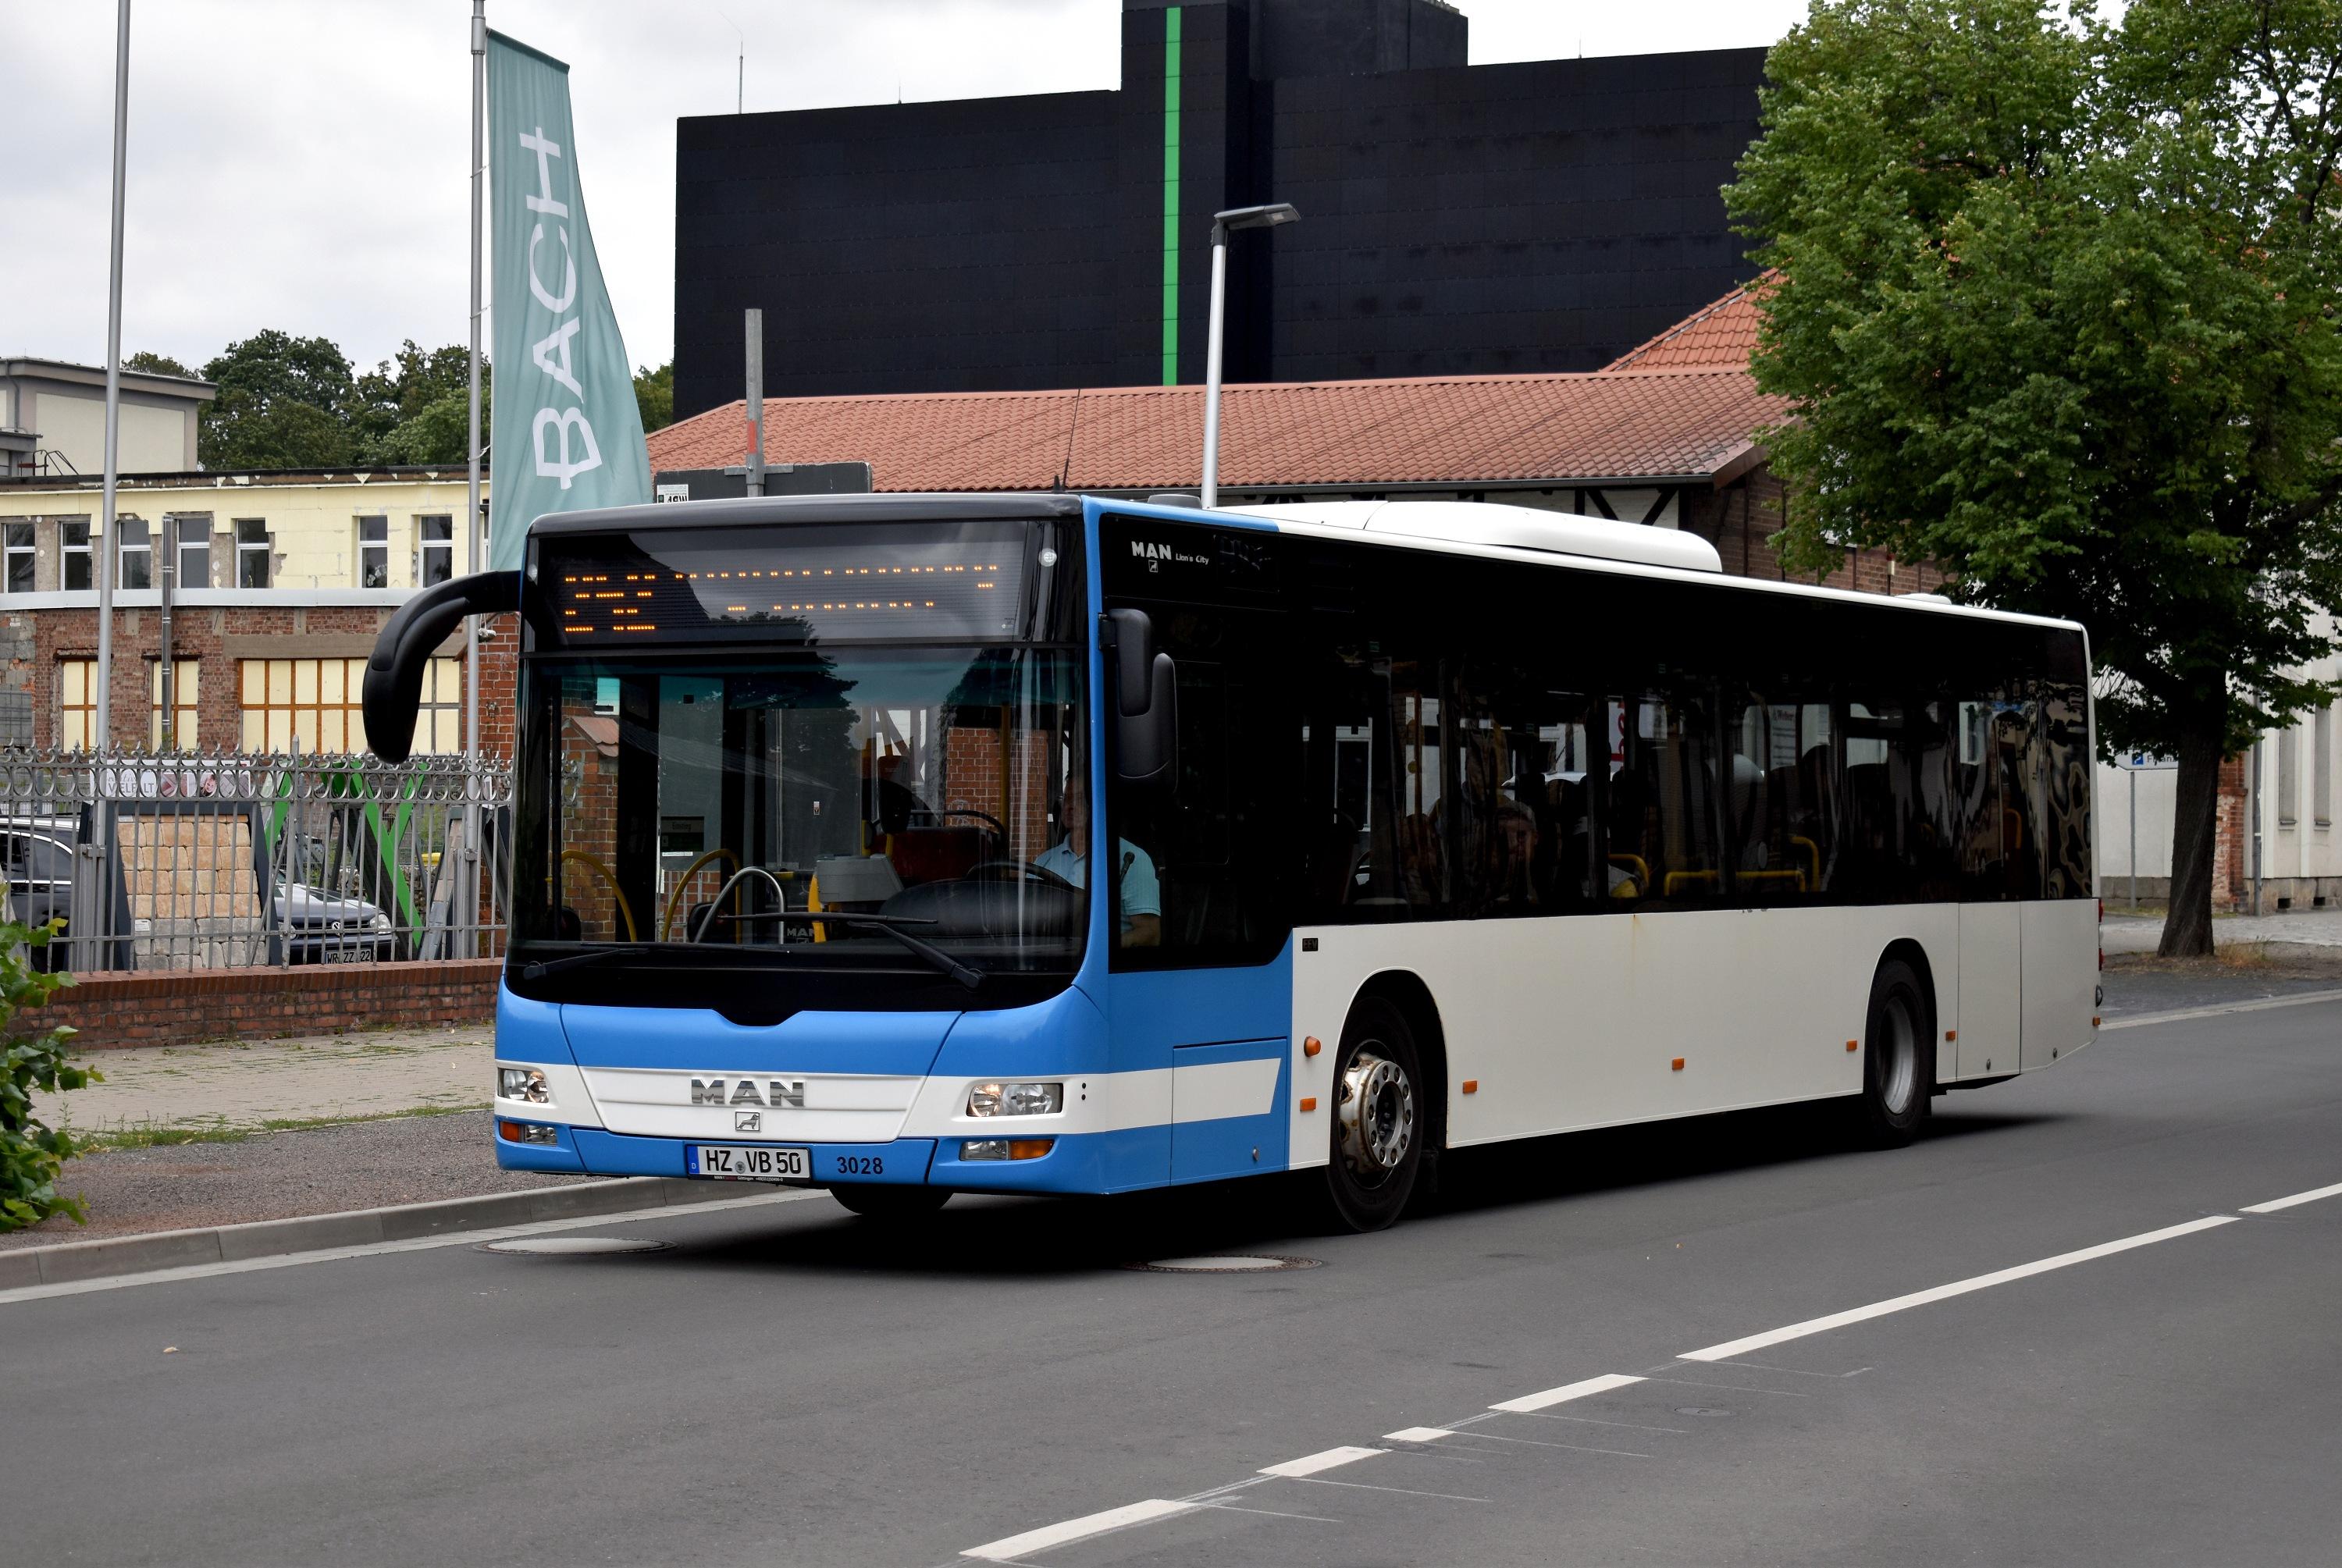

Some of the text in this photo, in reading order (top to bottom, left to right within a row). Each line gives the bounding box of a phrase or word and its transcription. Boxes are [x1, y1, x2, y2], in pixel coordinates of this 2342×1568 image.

[519, 126, 603, 490] BACH
[1131, 541, 1209, 565] MAN Lion's City
[343, 951, 354, 963] ZZ
[691, 1079, 806, 1107] MAN
[706, 1149, 732, 1172] HZ
[746, 1150, 772, 1174] VB
[776, 1151, 802, 1175] 50
[836, 1156, 884, 1175] 3028
